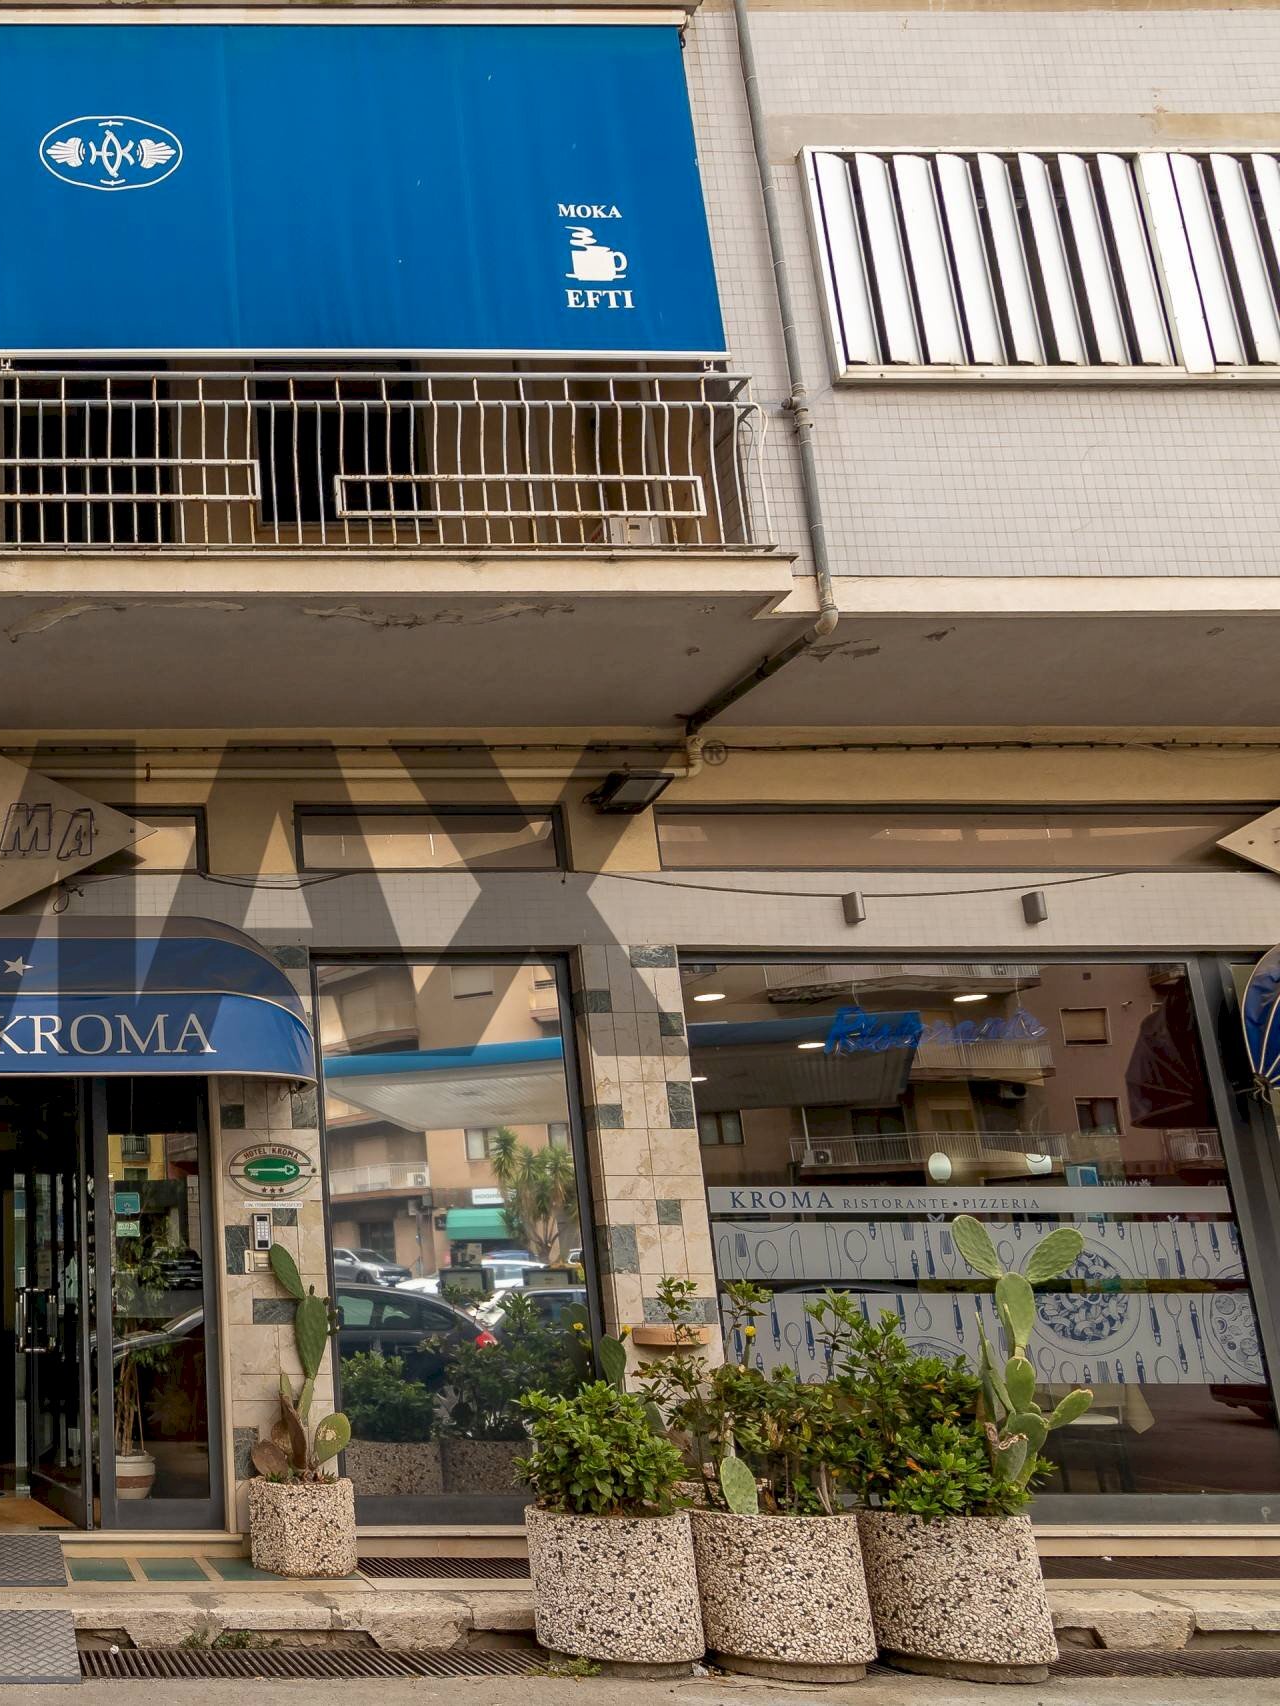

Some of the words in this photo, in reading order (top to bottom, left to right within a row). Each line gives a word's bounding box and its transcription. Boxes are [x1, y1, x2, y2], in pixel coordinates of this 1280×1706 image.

[557, 202, 623, 219] MOKA
[564, 288, 636, 309] EFTI
[243, 1147, 268, 1160] HOTEL
[271, 1147, 299, 1160] KROMA
[729, 1191, 834, 1209] KROMA
